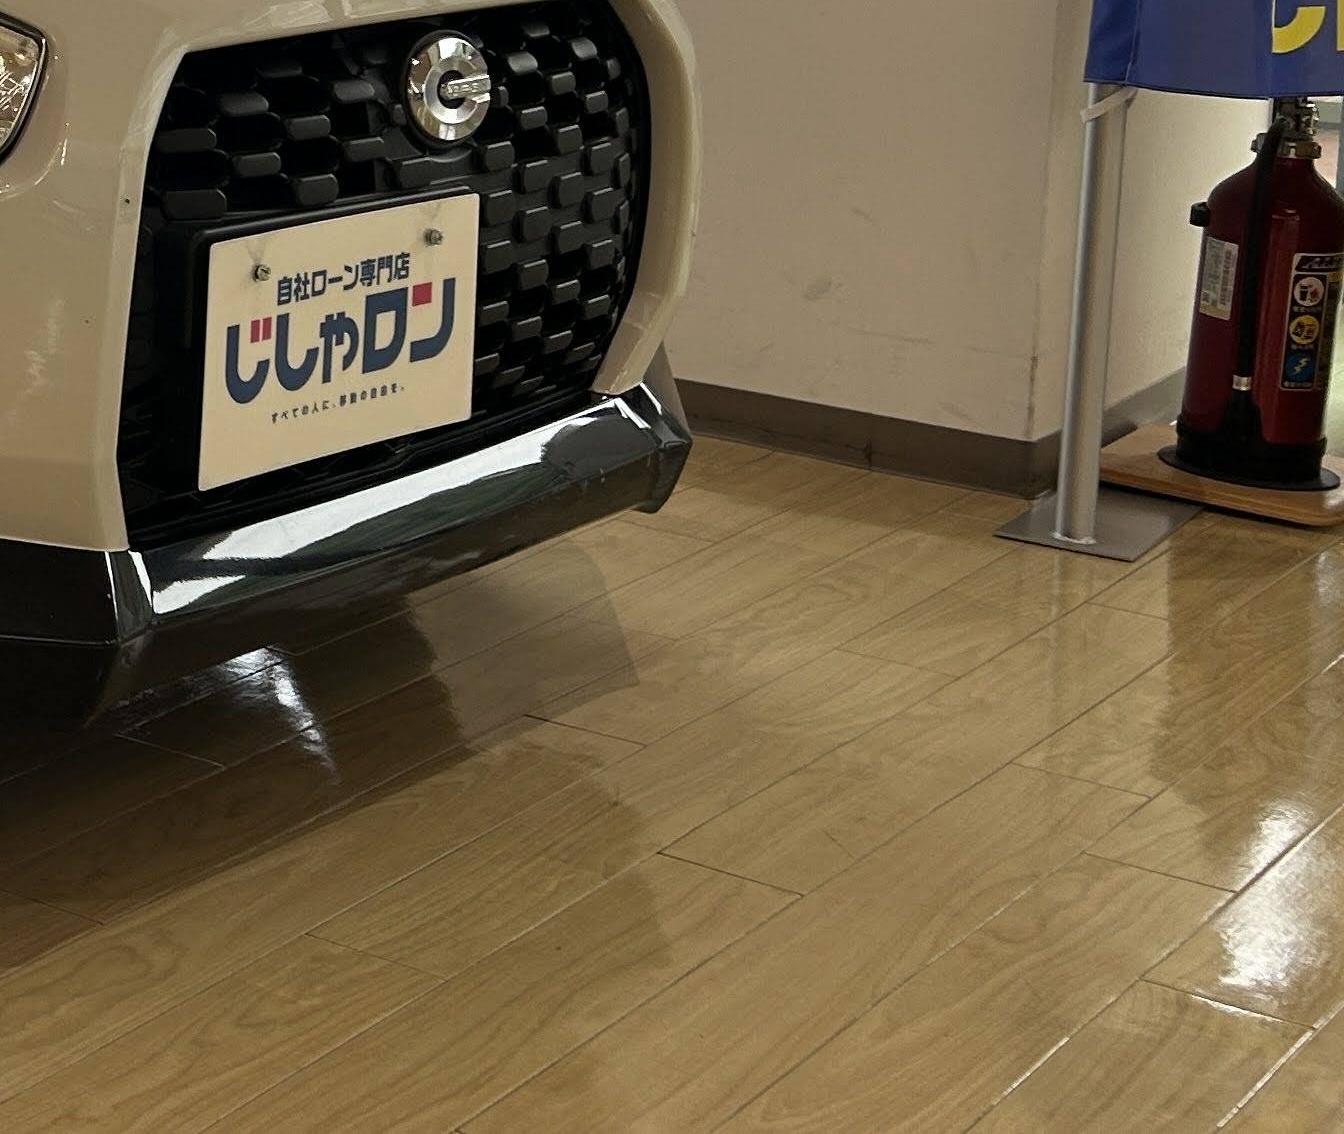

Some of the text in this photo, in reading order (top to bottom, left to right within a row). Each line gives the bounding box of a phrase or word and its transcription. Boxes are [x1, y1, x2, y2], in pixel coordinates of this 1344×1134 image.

[276, 251, 411, 306] 自社ローン専門店
